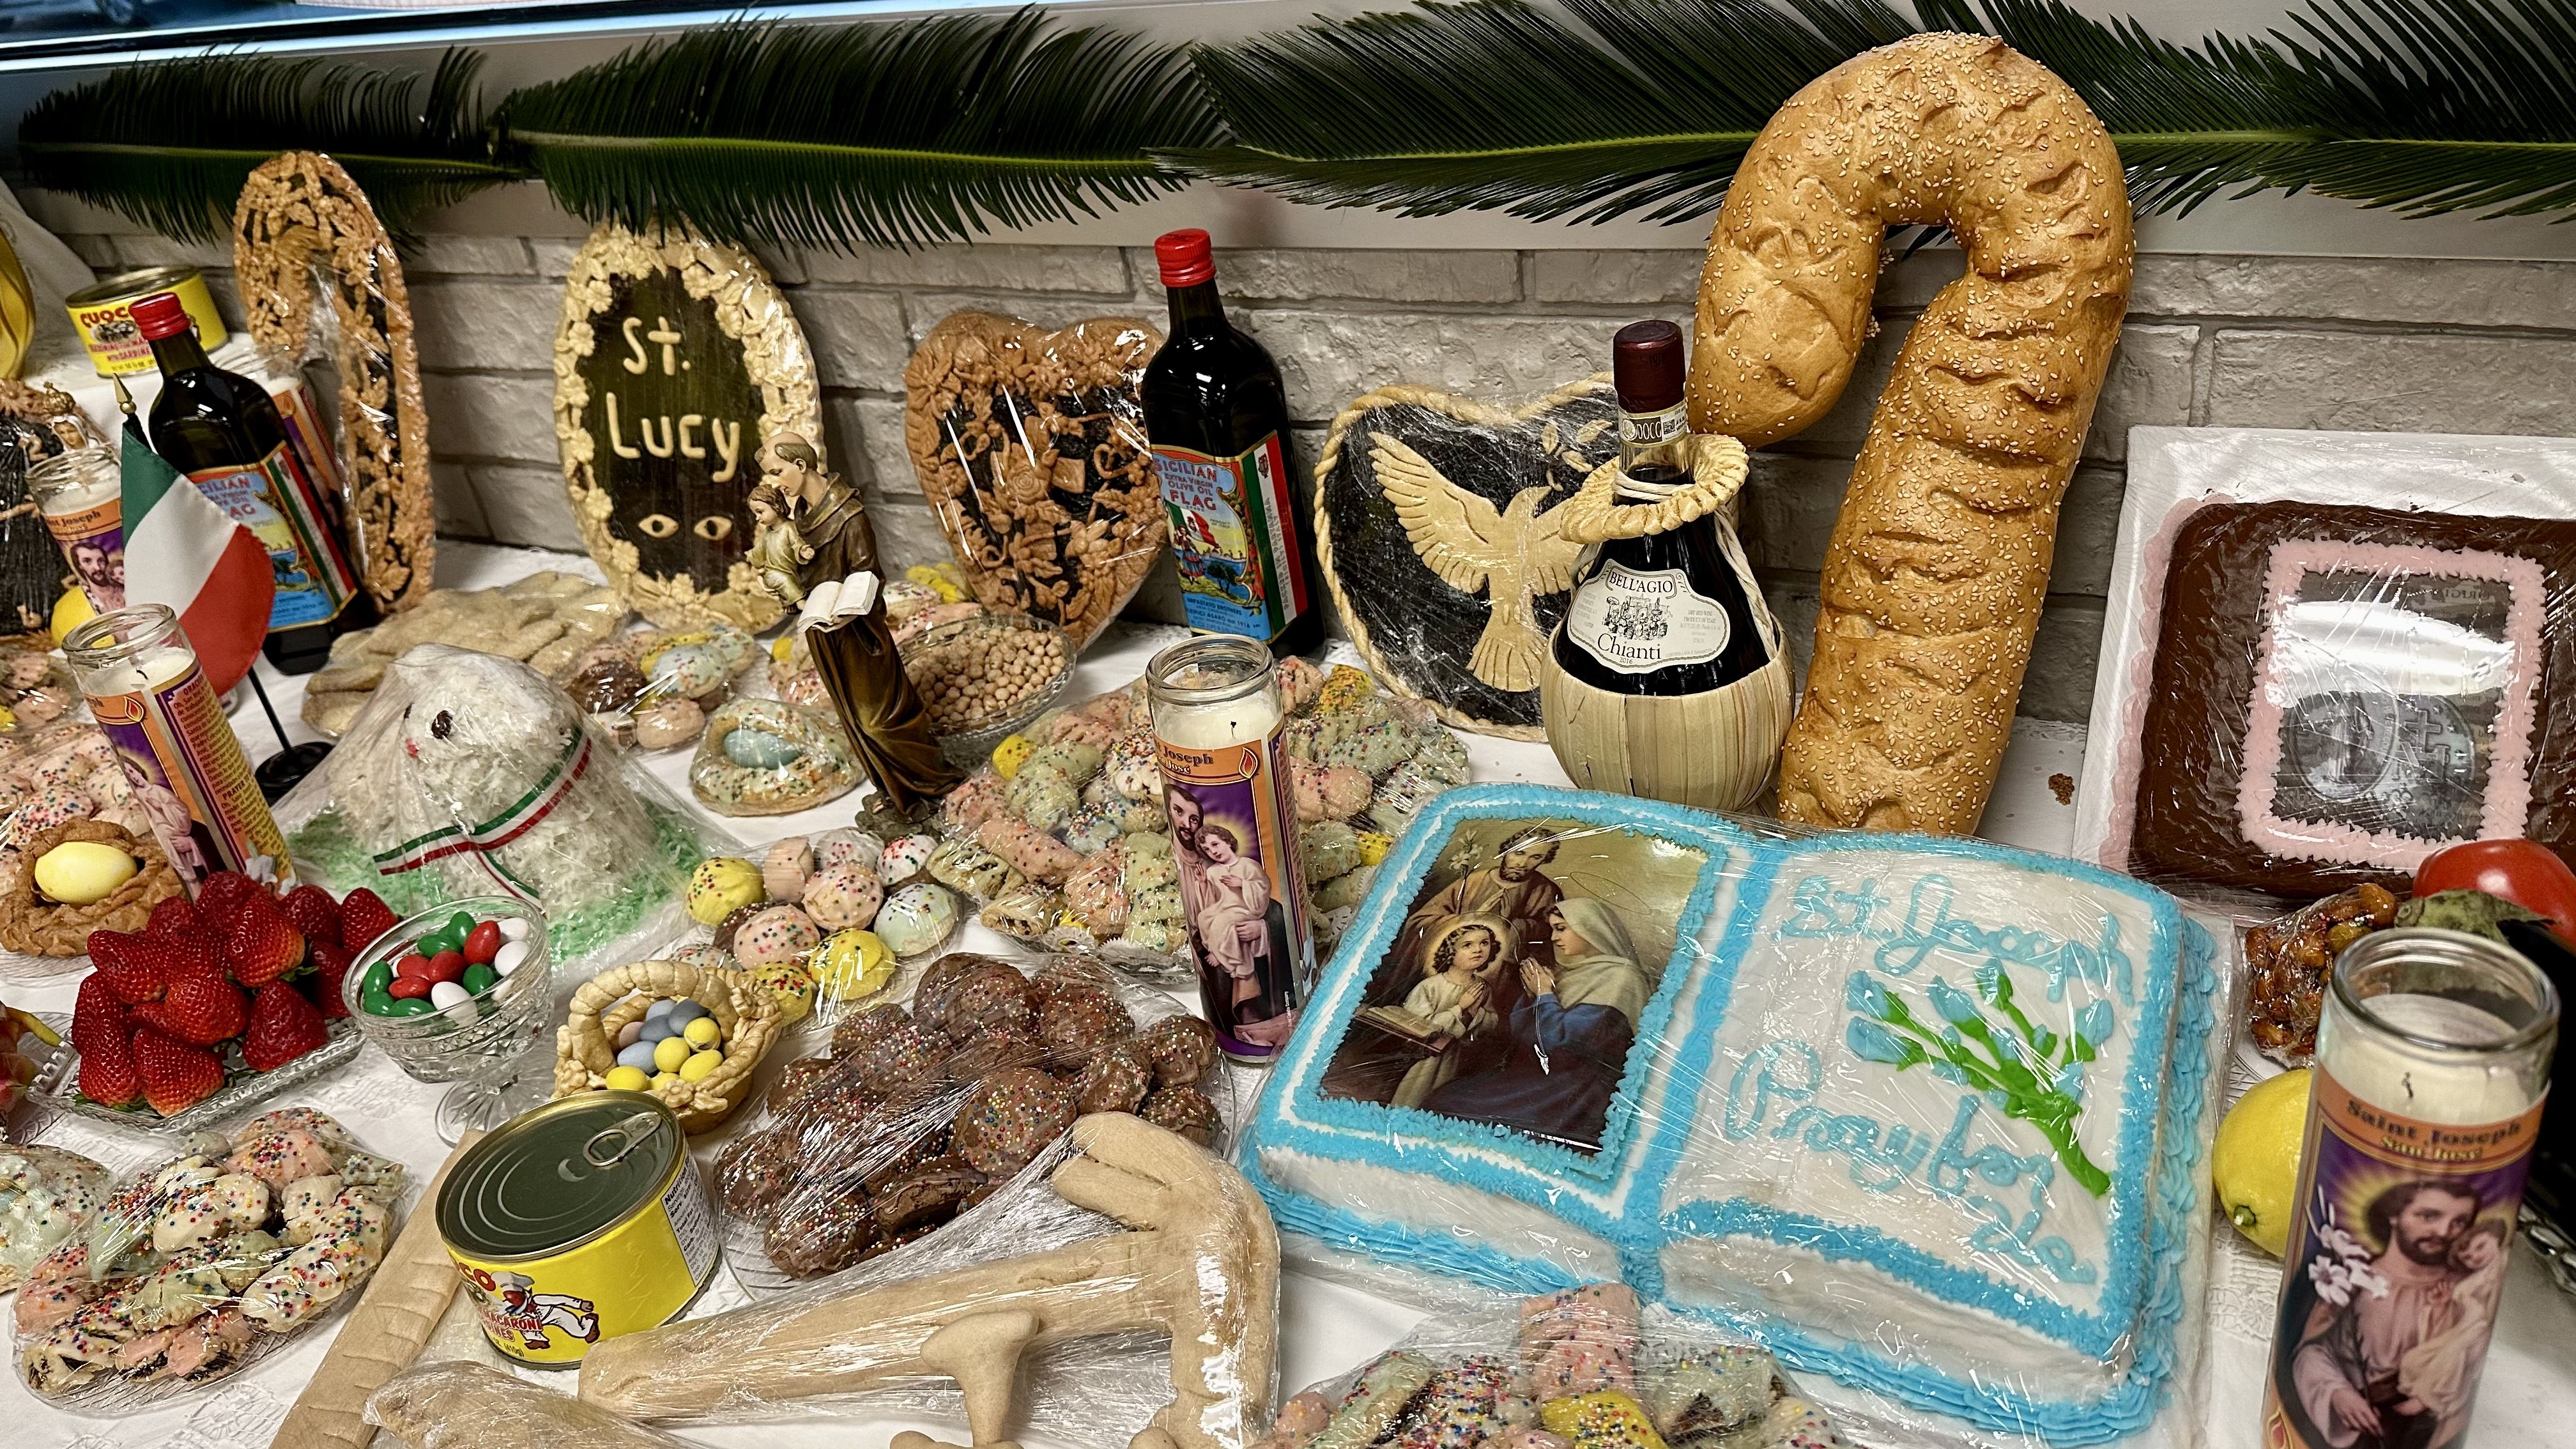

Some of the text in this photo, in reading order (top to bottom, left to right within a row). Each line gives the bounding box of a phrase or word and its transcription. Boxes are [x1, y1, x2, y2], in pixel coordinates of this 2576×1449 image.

[80, 307, 129, 328] CUOC
[623, 316, 692, 376] St.
[606, 392, 740, 483] Lucy
[1637, 422, 1662, 440] DOCG
[1153, 457, 1217, 482] SICILIAN
[1168, 480, 1213, 496] OLIVE OIL
[1170, 489, 1217, 510] FLAG
[1609, 571, 1673, 593] BELL'AGIO
[1597, 632, 1662, 660] Chianti
[1163, 745, 1214, 767] Joseph
[222, 780, 246, 801] PRAYER
[2346, 1099, 2521, 1146] Saint Joseph
[2381, 1135, 2424, 1158] San
[664, 1167, 687, 1206] Nutrition
